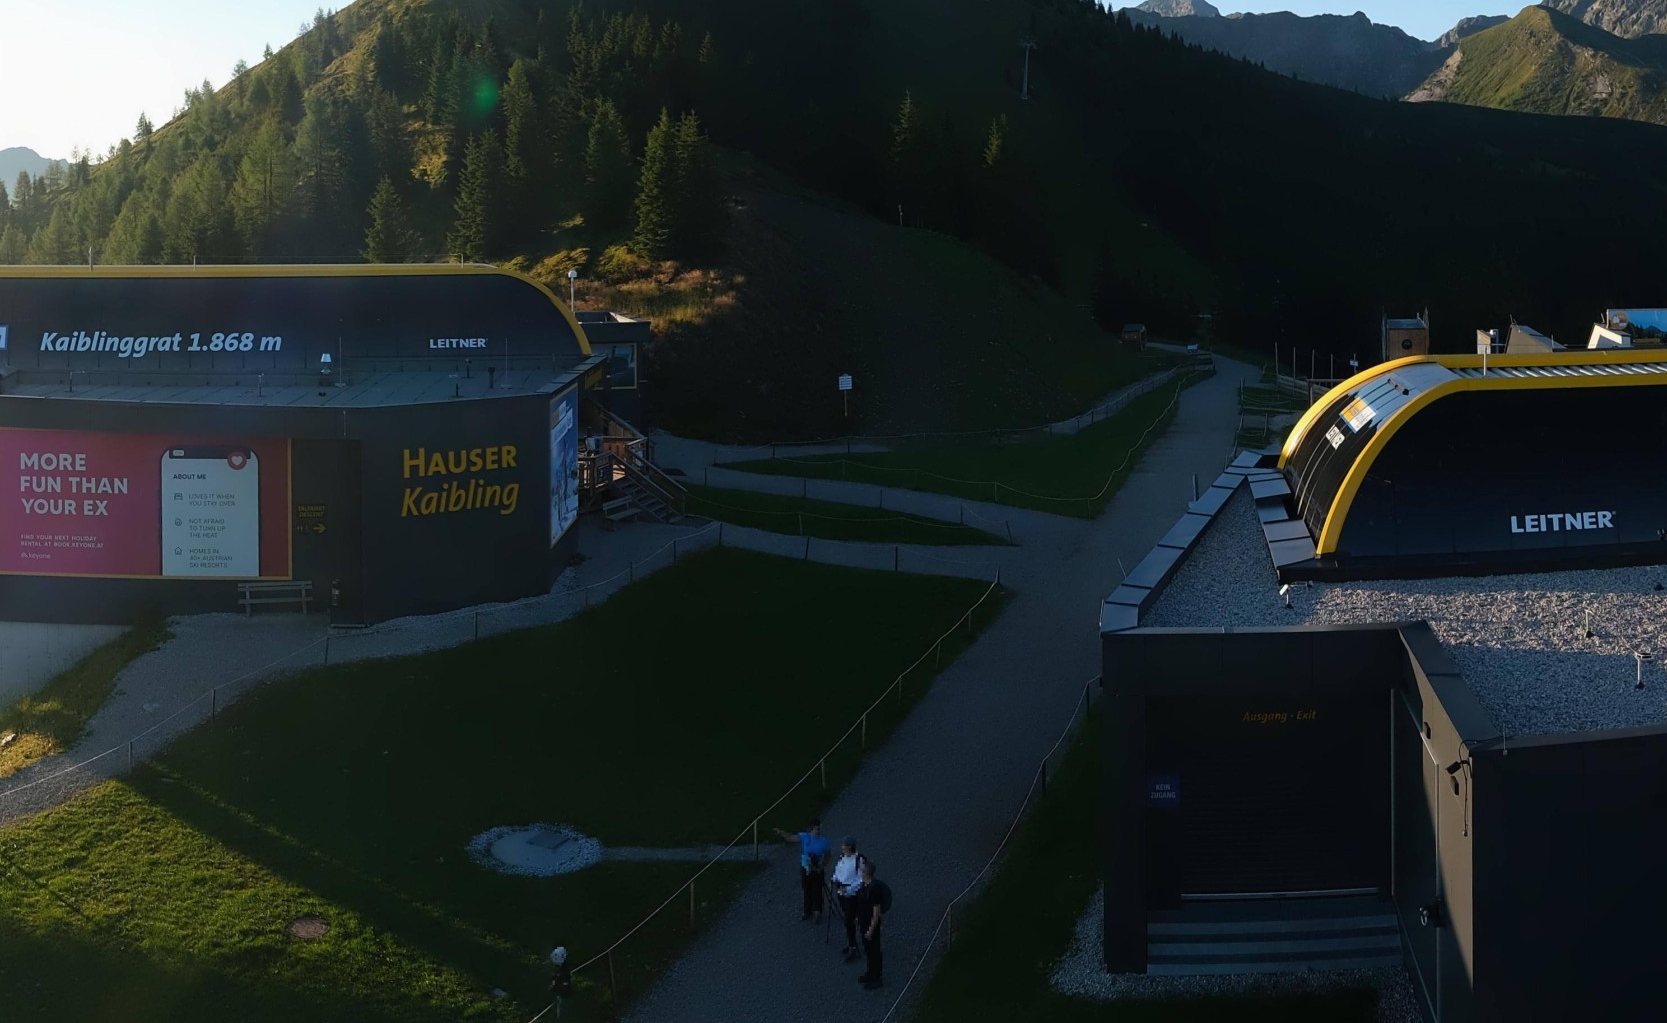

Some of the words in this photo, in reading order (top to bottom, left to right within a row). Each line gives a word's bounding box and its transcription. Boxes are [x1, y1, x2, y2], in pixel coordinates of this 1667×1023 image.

[40, 331, 182, 357] Kaiblinggrat
[187, 332, 254, 352] 1.868
[259, 336, 282, 351] m
[429, 338, 487, 349] LEITNER
[20, 452, 87, 471] MORE
[403, 445, 518, 478] HAUSER
[20, 476, 61, 493] FUN
[68, 477, 128, 494] THAN
[21, 498, 77, 515] YOUR
[83, 500, 109, 516] EX
[401, 479, 520, 518] Kaibling
[1510, 511, 1614, 533] LEITNER
[1242, 711, 1288, 723] Ausgang
[1296, 709, 1317, 720] Exit
